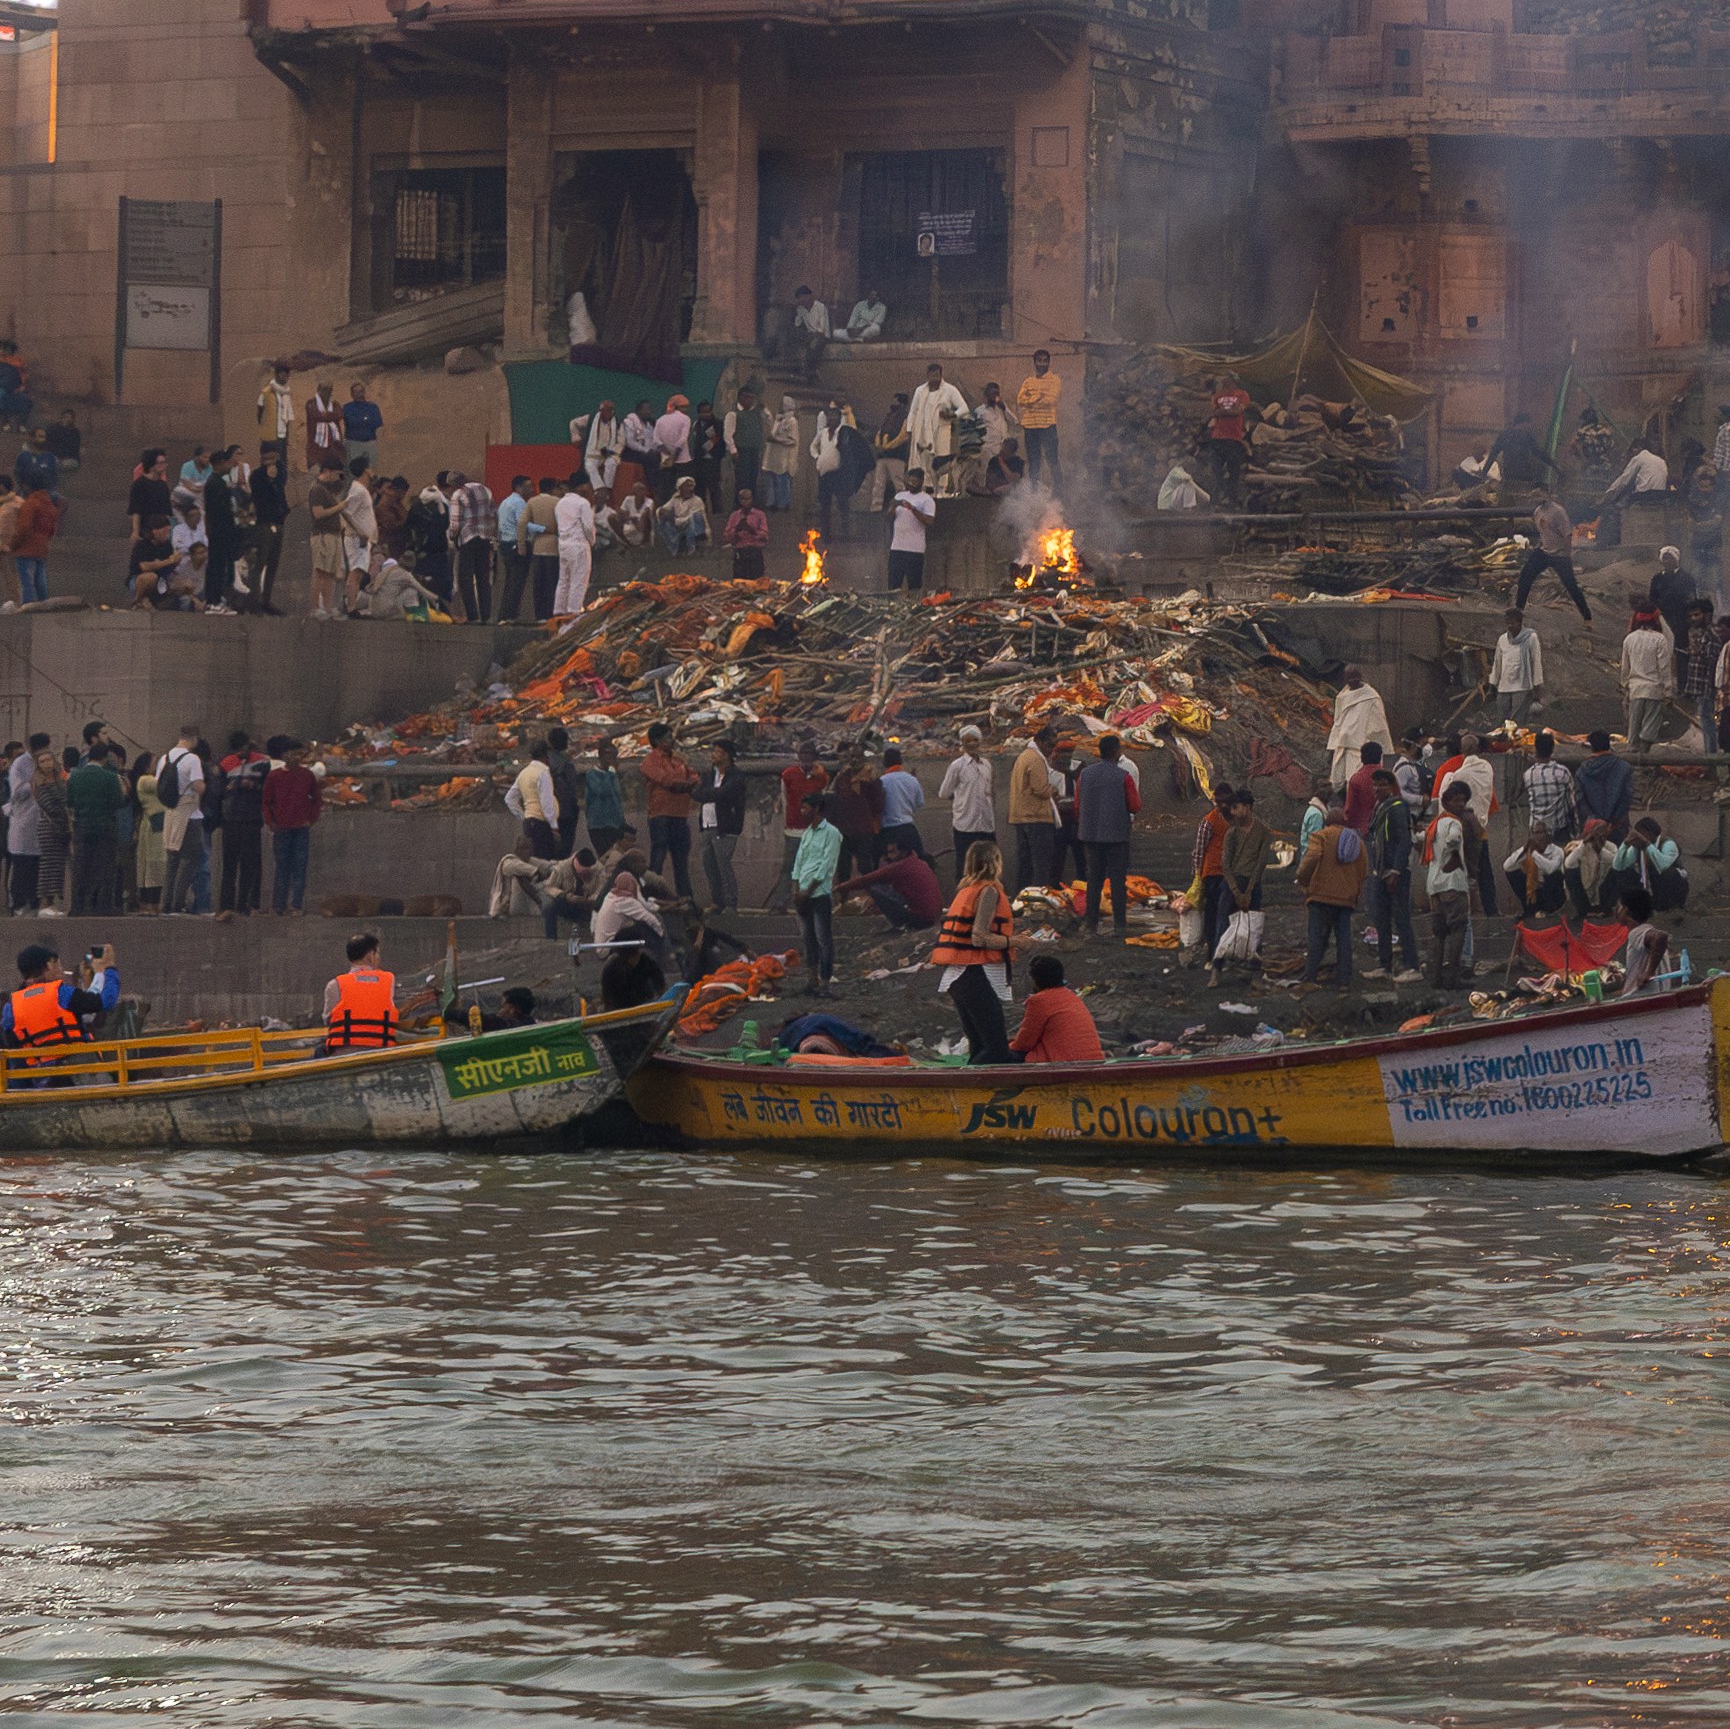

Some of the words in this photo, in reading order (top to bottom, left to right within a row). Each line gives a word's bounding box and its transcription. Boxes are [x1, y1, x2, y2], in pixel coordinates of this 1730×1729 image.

[454, 1045, 550, 1090] सीएनजी
[556, 1052, 586, 1070] नाव
[810, 1092, 840, 1127] की
[960, 1102, 1038, 1133] JSW
[1071, 1097, 1283, 1140] Colouron+
[1400, 1099, 1440, 1123] Toll
[1442, 1094, 1488, 1120] Free
[1522, 1072, 1652, 1113] 1800225225
